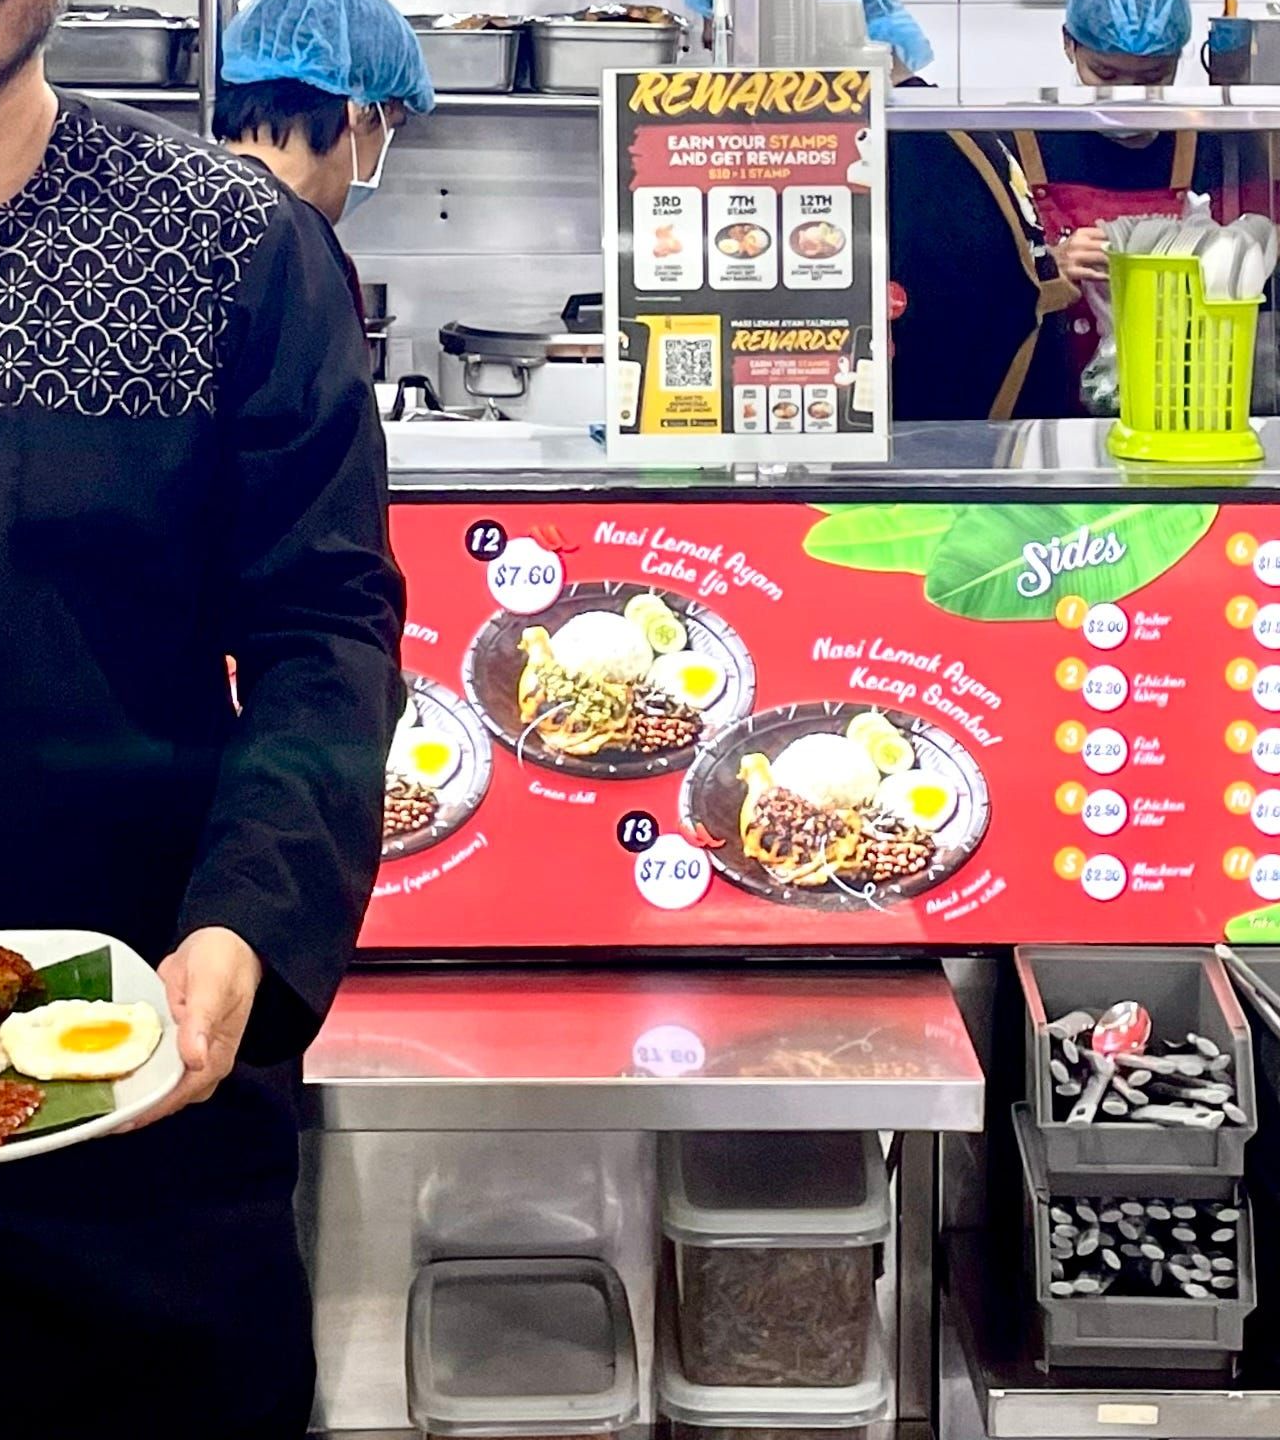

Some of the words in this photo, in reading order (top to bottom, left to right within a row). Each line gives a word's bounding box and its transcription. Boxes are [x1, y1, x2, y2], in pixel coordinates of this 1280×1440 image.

[628, 71, 872, 116] REWARDS!
[667, 135, 715, 150] EARN
[716, 135, 767, 150] YOUR
[768, 134, 839, 149] STAMPS
[669, 151, 708, 166] AND
[710, 151, 745, 166] GET
[746, 150, 837, 166] REWARDS!
[748, 168, 791, 179] STAMP
[653, 196, 681, 208] 3RD
[729, 195, 754, 207] 7TH
[799, 194, 833, 207] 12TH
[732, 329, 851, 352] REWARDS!
[471, 527, 500, 551] 12
[593, 521, 650, 546] Nasi
[650, 527, 725, 565] Lemak
[725, 551, 784, 601] Ayam
[640, 551, 697, 582] Cabe
[1015, 524, 1128, 598] Sides
[493, 564, 557, 588] $7.60
[812, 636, 867, 661] Nasi
[869, 637, 943, 674] Lemak
[942, 661, 1003, 710] Ayam
[1065, 664, 1078, 684] 2
[1133, 673, 1187, 688] Chicken
[849, 666, 918, 704] Kecap
[921, 683, 1004, 748] Sambal
[1132, 735, 1161, 750] Fish
[1132, 797, 1186, 812] Chicken
[1230, 788, 1252, 808] 10
[622, 818, 654, 843] 13
[640, 858, 702, 884] $7.60
[1228, 853, 1251, 874] 11
